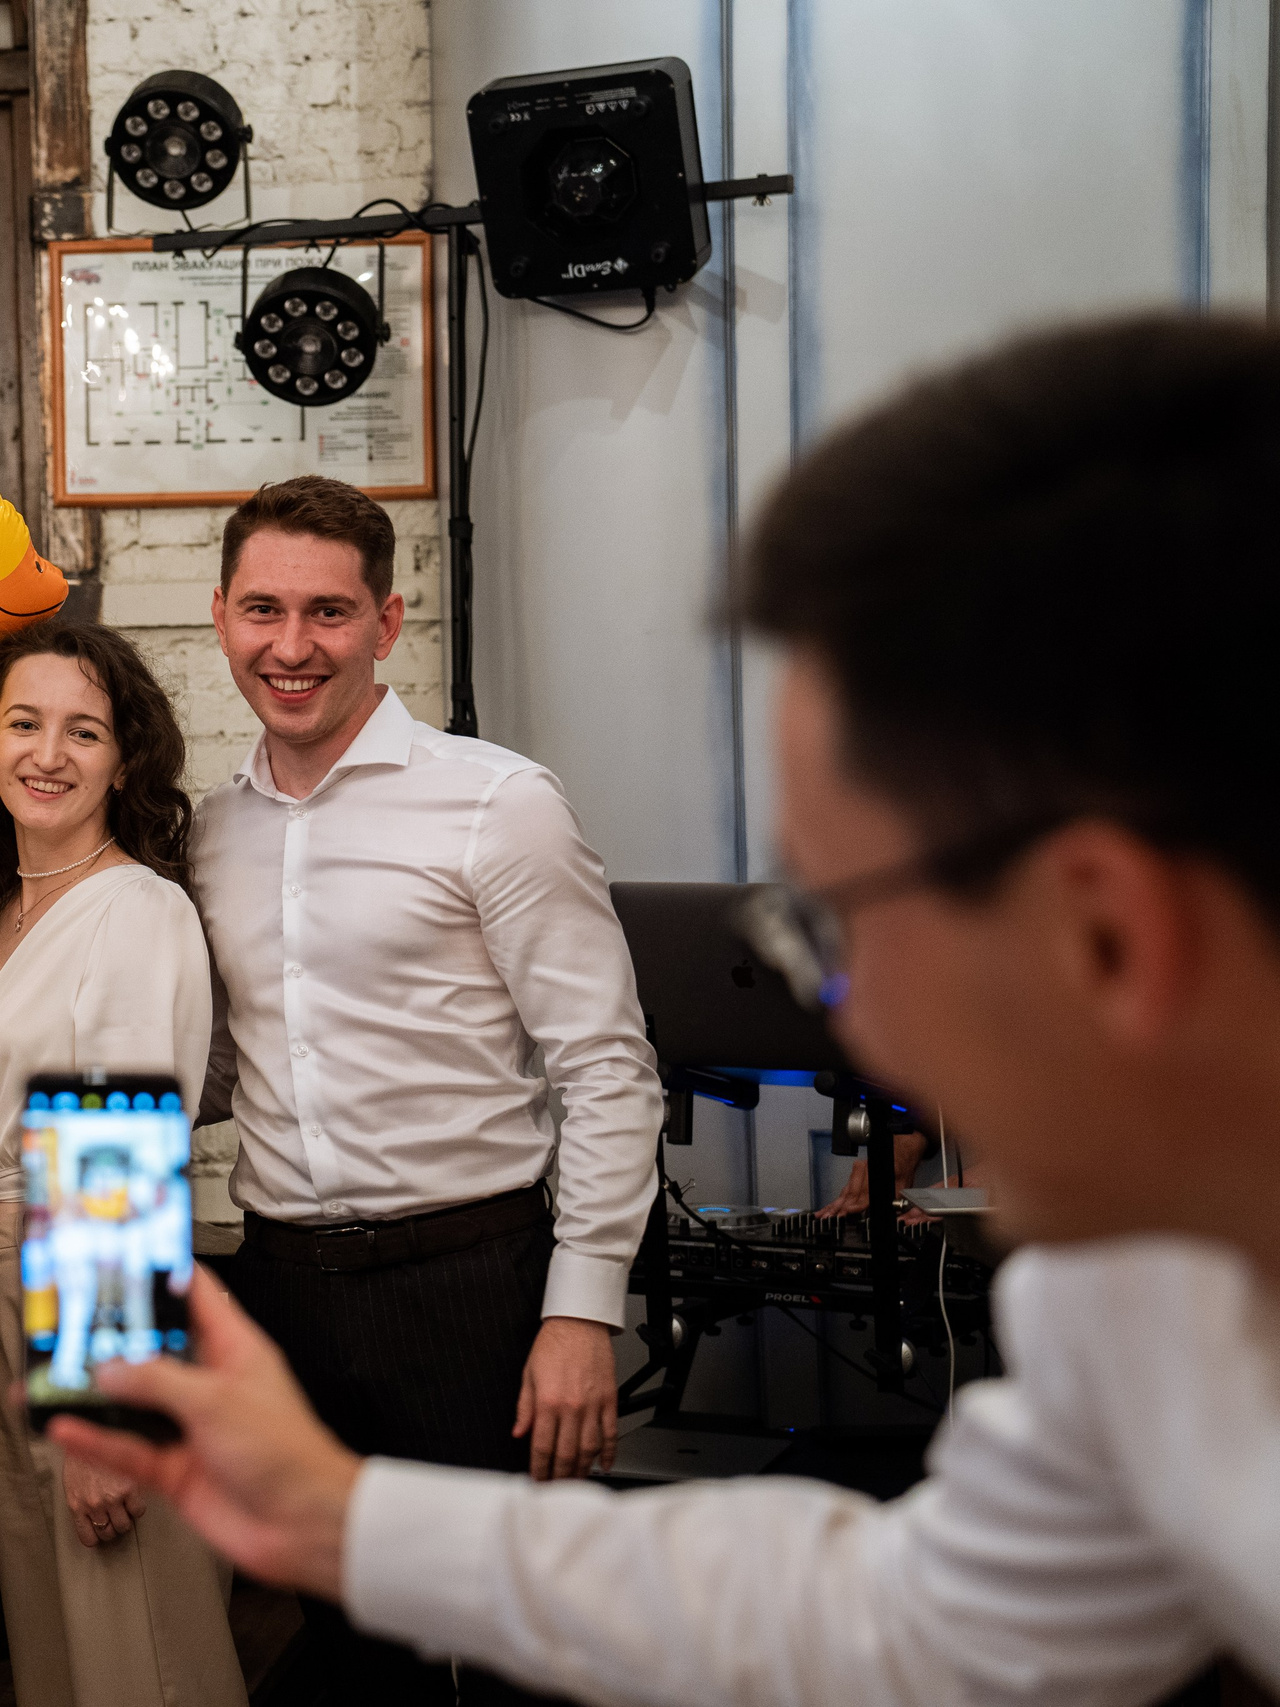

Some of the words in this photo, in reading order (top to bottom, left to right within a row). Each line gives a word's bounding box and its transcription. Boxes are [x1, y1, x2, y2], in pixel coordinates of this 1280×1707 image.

[132, 260, 169, 271] ПЛАН
[172, 258, 250, 271] ЭВАКУАЦИ
[765, 1292, 810, 1303] PROEL
